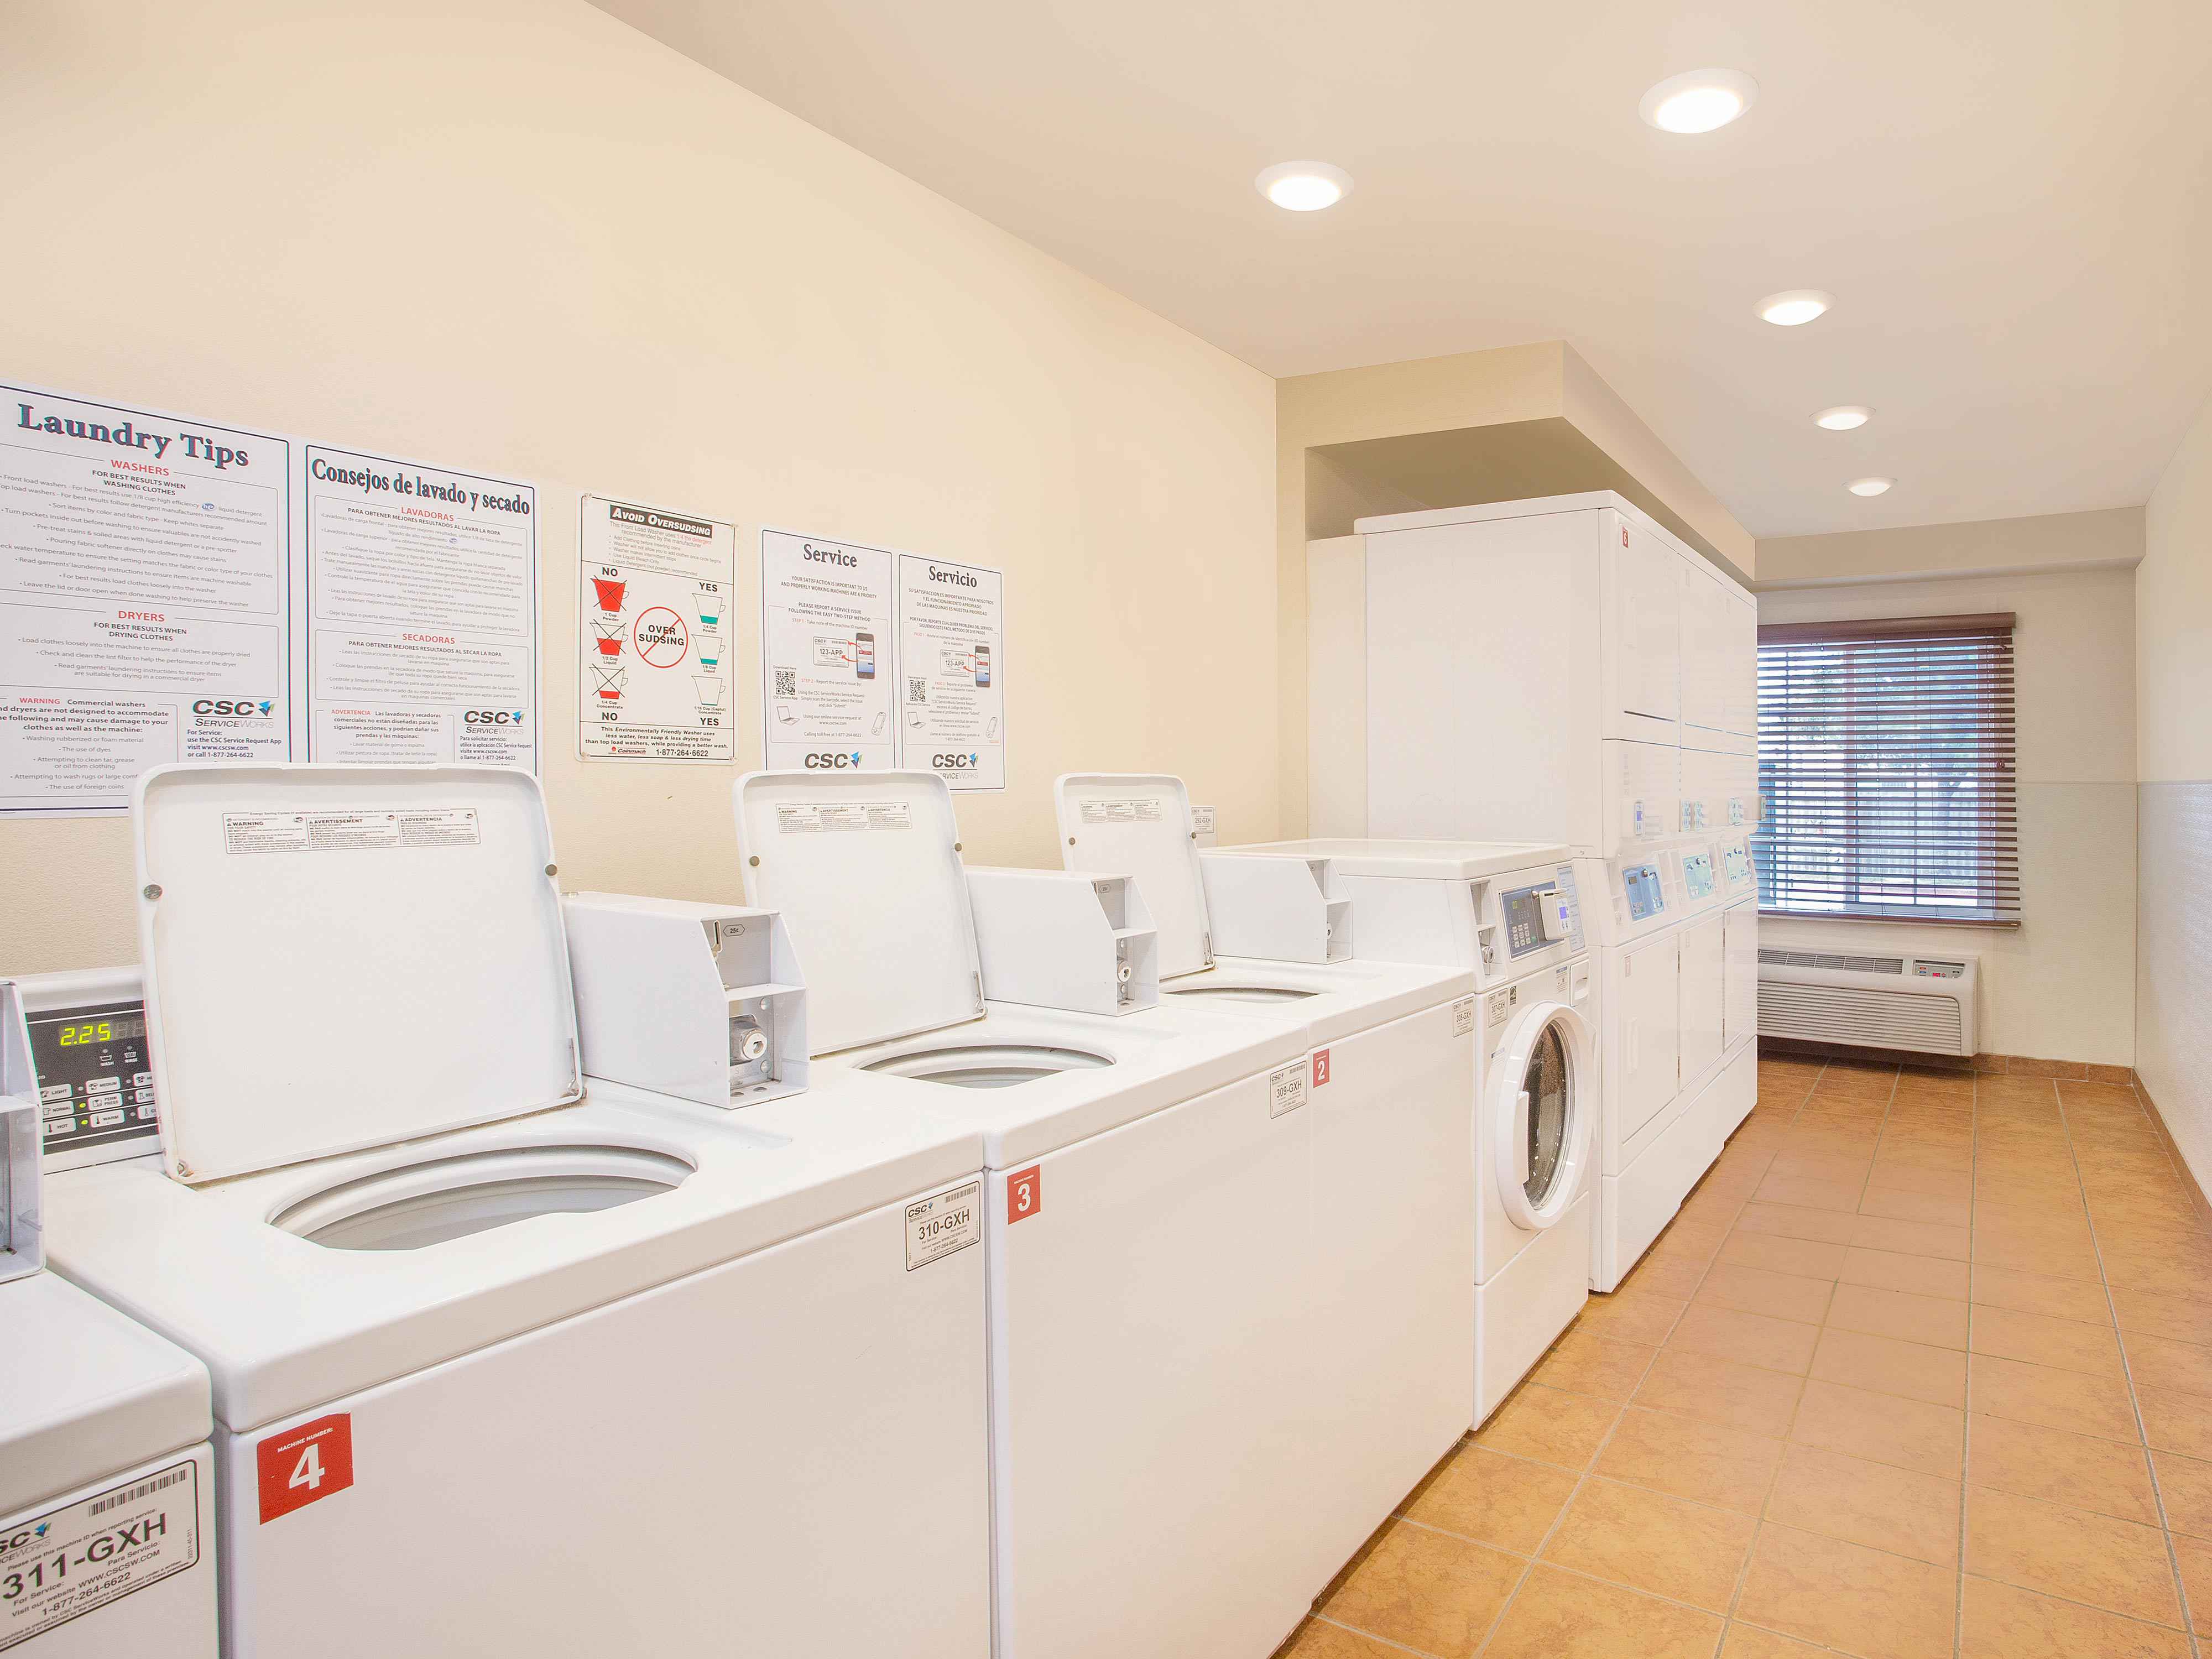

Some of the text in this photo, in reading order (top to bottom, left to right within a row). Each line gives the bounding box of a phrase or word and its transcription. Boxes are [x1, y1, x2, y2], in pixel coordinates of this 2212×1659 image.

[17, 403, 249, 470] Laundry Tips
[110, 459, 169, 476] WASHERS
[103, 479, 175, 495] WASHING CLOTHES
[130, 476, 162, 486] RESULTS
[163, 481, 186, 489] WHEN
[311, 458, 530, 515] Consejos de lavado y secado
[364, 510, 391, 519] OBTENER
[392, 514, 418, 523] MEJORES
[419, 519, 453, 528] RESULTADOS
[401, 507, 453, 521] LAVADORAS
[803, 544, 857, 567] Service
[602, 567, 618, 576] NO
[928, 566, 977, 587] Servicio
[699, 582, 718, 592] YES
[803, 577, 831, 586] SATISFACTION
[118, 611, 164, 622] DRYERS
[402, 633, 455, 644] SECADORAS
[648, 625, 676, 635] OVER
[639, 634, 685, 646] SUDSING
[192, 700, 254, 717] CSC
[602, 712, 618, 721] NO
[194, 718, 274, 728] SERVICEWORKS
[464, 710, 509, 725] CSC
[465, 726, 524, 735] SERVICEWORKS
[804, 753, 848, 769] CSC
[932, 754, 967, 768] CSC
[60, 1023, 111, 1046] 2.25
[1271, 1073, 1281, 1082] CSC
[1318, 1061, 1325, 1081] 2
[1276, 1079, 1302, 1098] 309-GXH
[1018, 1183, 1030, 1211] 3
[908, 1204, 927, 1217] CSC
[919, 1209, 969, 1240] 310-GXH
[277, 1427, 333, 1453] MACHINE NUMBER:
[289, 1443, 325, 1490] 4
[0, 1531, 31, 1553] SC
[7, 1559, 29, 1571] Please
[56, 1538, 82, 1551] machine
[91, 1528, 107, 1537] when
[108, 1517, 134, 1531] reporting
[135, 1508, 157, 1520] service:
[0, 1539, 51, 1564] CEWORKS
[2, 1512, 167, 1600] 311-GXH
[108, 1541, 160, 1566] Para Servicio:
[12, 1549, 160, 1617] Visit our website WWW.CSCSW.COM
[13, 1581, 64, 1606] For Service:
[41, 1571, 131, 1616] 1-877-264-6622
